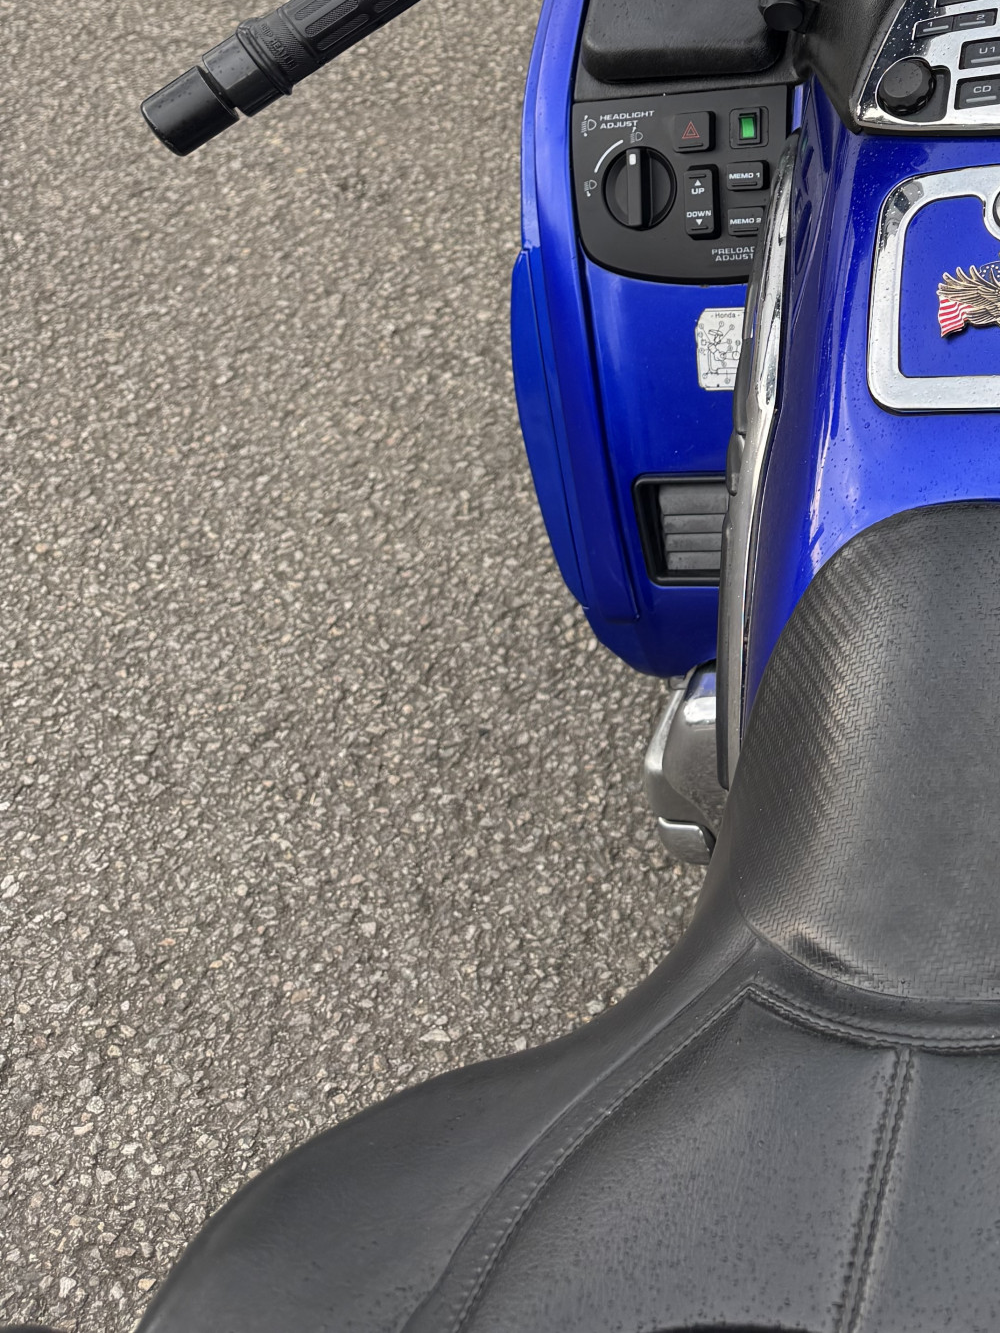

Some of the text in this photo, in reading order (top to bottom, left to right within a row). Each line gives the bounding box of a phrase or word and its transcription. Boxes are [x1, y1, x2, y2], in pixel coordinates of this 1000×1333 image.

[973, 85, 991, 93] CD
[600, 110, 655, 121] HEADLIGHT
[600, 120, 638, 130] ADJUST
